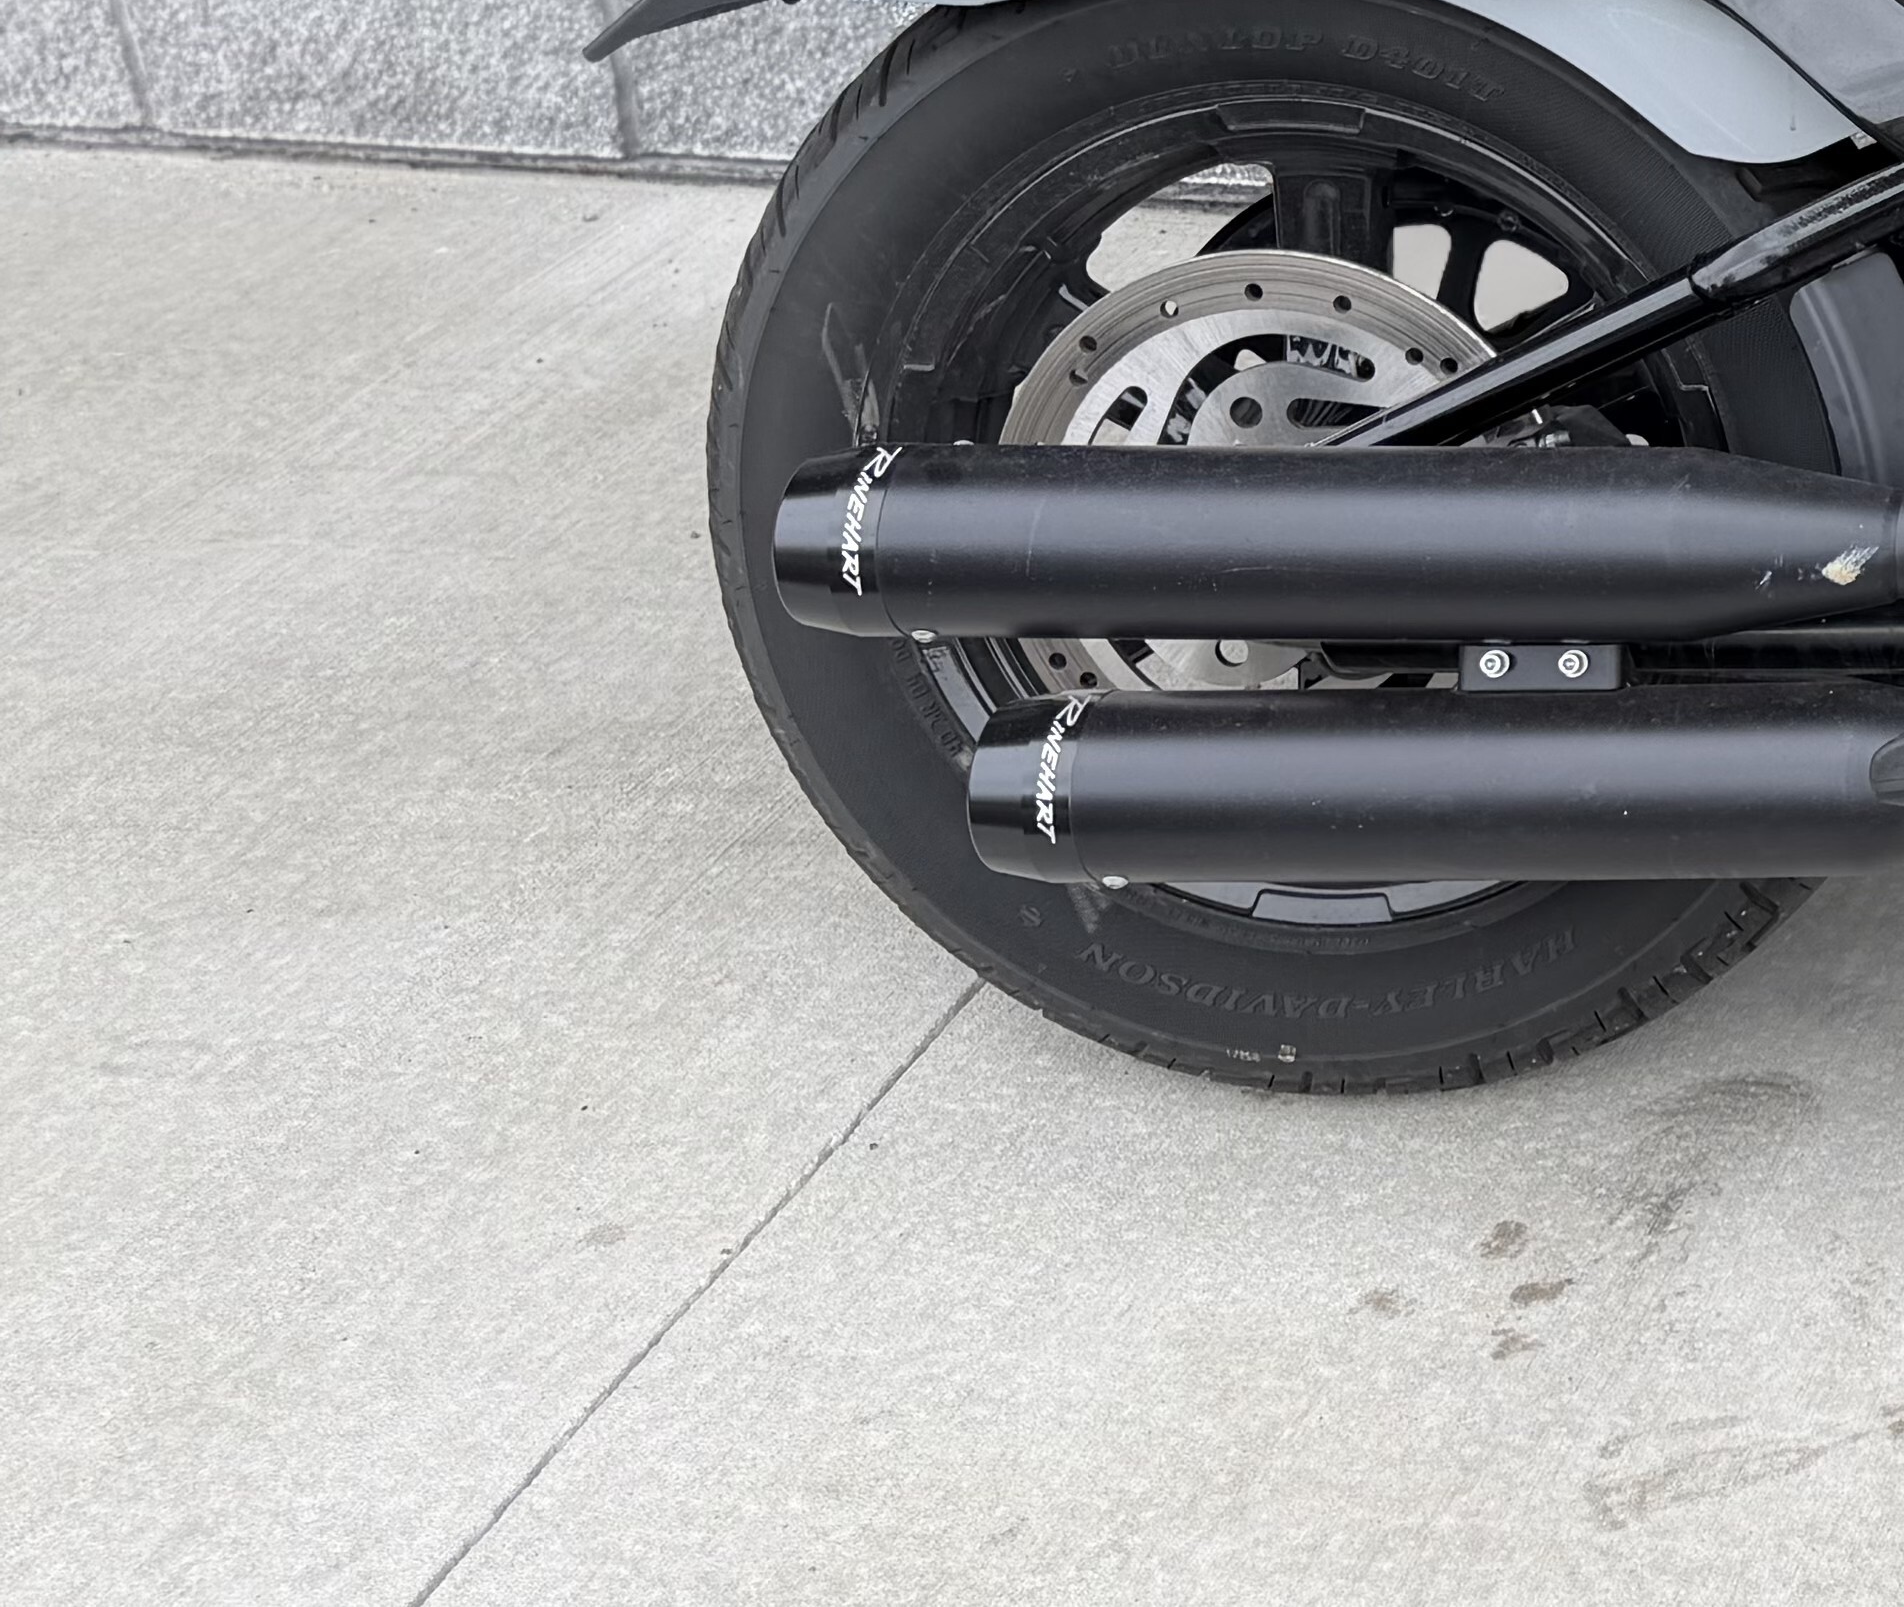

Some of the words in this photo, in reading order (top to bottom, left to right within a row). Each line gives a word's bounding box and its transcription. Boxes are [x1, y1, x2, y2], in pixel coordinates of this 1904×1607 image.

[840, 445, 903, 596] RINEHART
[1035, 695, 1092, 844] RINEHART
[1077, 924, 1580, 1021] HARLEY-DAVIDSON
